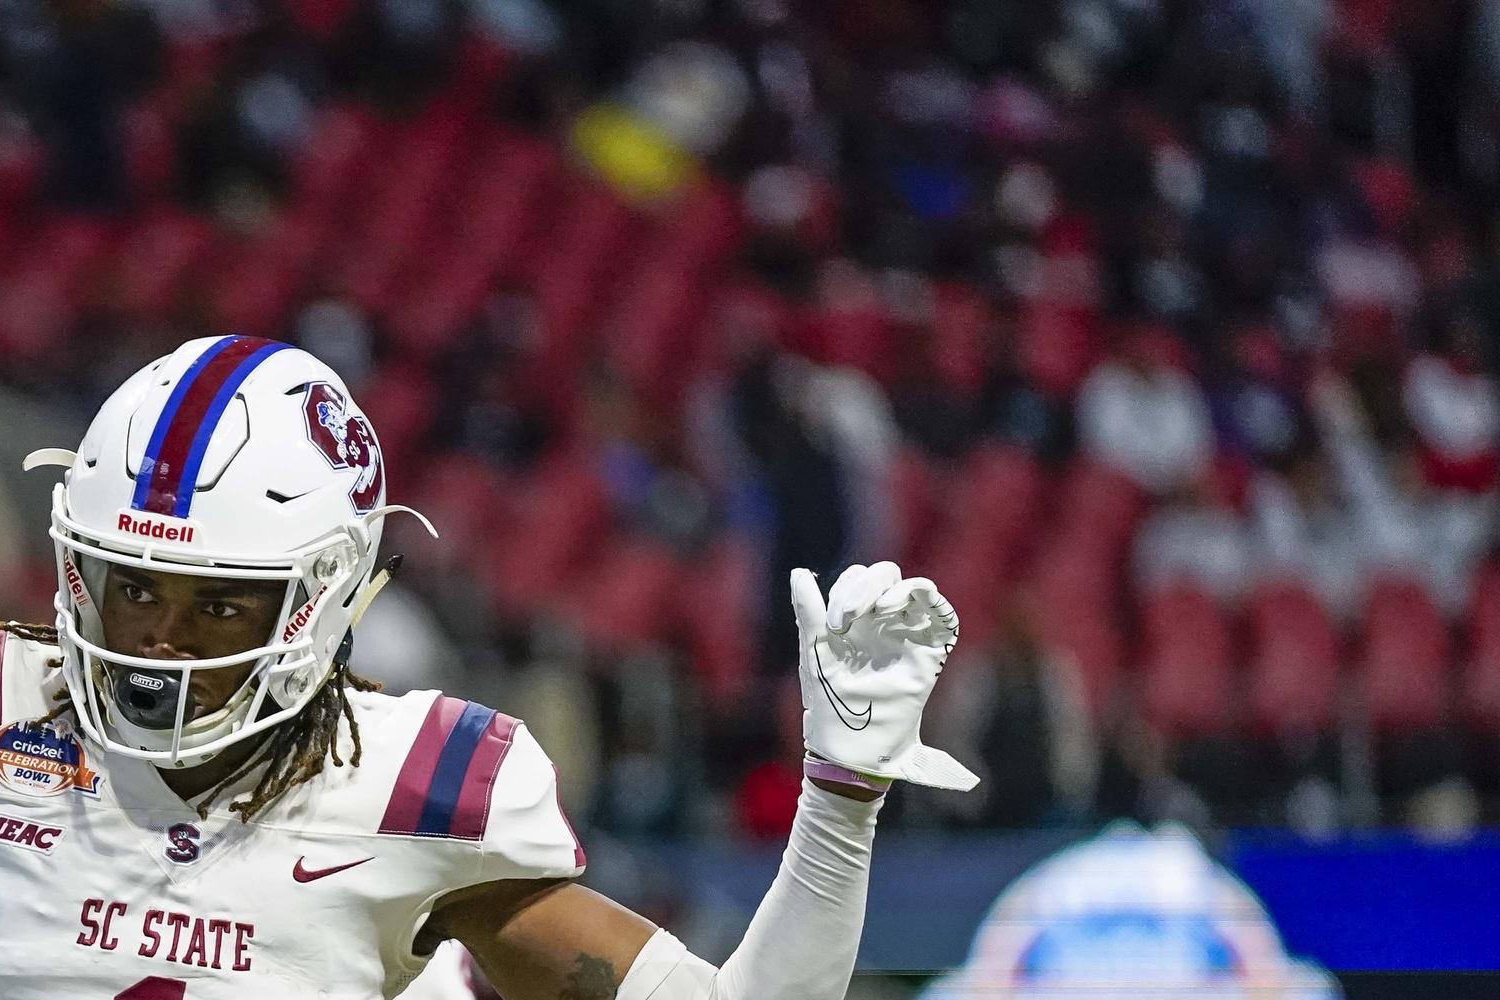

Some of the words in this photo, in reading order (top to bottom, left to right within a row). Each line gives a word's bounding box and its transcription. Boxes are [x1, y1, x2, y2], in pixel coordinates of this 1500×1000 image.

[118, 514, 194, 542] Riddell
[65, 560, 88, 607] ddell
[131, 675, 161, 689] BATTLE
[12, 740, 65, 760] cricket
[13, 767, 52, 784] BOWL
[76, 898, 127, 950] SC
[138, 909, 254, 971] STATE
